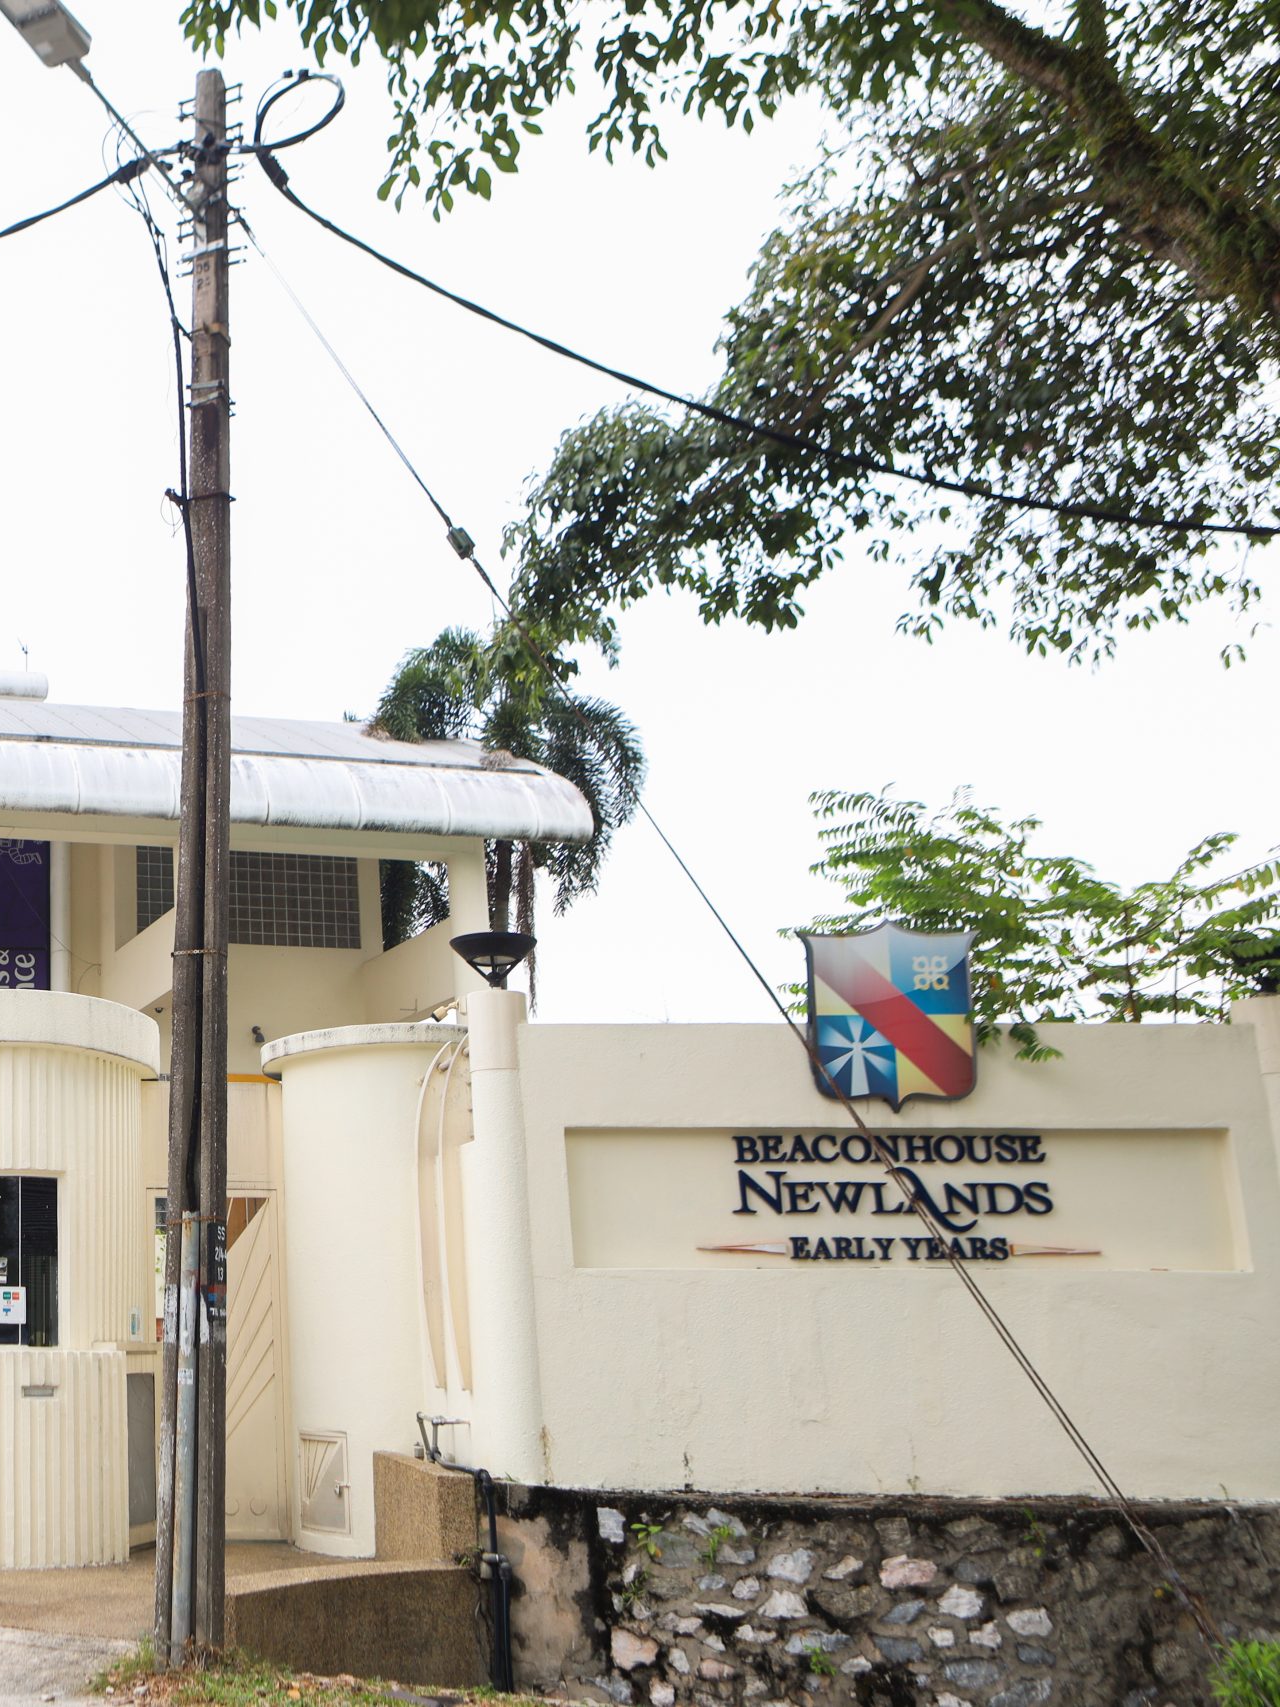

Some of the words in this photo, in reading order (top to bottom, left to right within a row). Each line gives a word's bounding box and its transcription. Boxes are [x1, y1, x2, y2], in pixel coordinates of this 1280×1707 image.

[732, 1134, 1047, 1164] BEACONHOUSE
[732, 1166, 1054, 1233] NEWLANDS
[217, 1225, 226, 1241] SS
[789, 1236, 896, 1260] EARLY
[902, 1236, 1010, 1261] YEARS
[217, 1266, 224, 1281] 13
